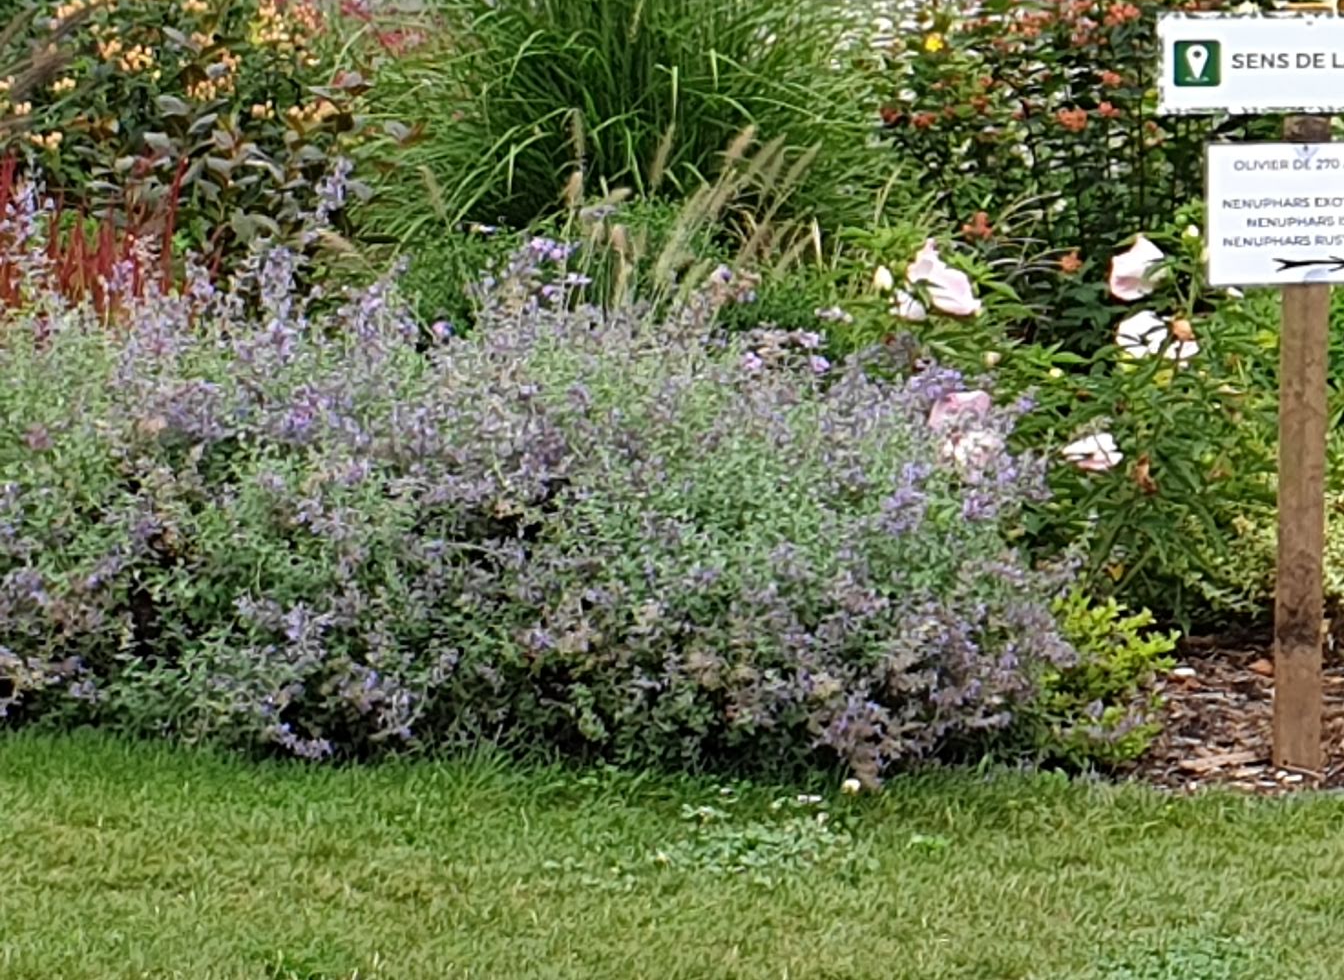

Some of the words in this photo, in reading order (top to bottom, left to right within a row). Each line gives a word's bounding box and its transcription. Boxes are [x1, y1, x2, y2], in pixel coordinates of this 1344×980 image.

[1231, 53, 1289, 69] SENS
[1295, 53, 1325, 68] DE
[1234, 159, 1289, 171] OLIVIER
[1293, 158, 1311, 170] DE
[1316, 158, 1340, 170] 270
[1222, 197, 1310, 209] NENUPHARS
[1246, 217, 1335, 228] NENUPHARS
[1222, 236, 1311, 248] NENUPHARS
